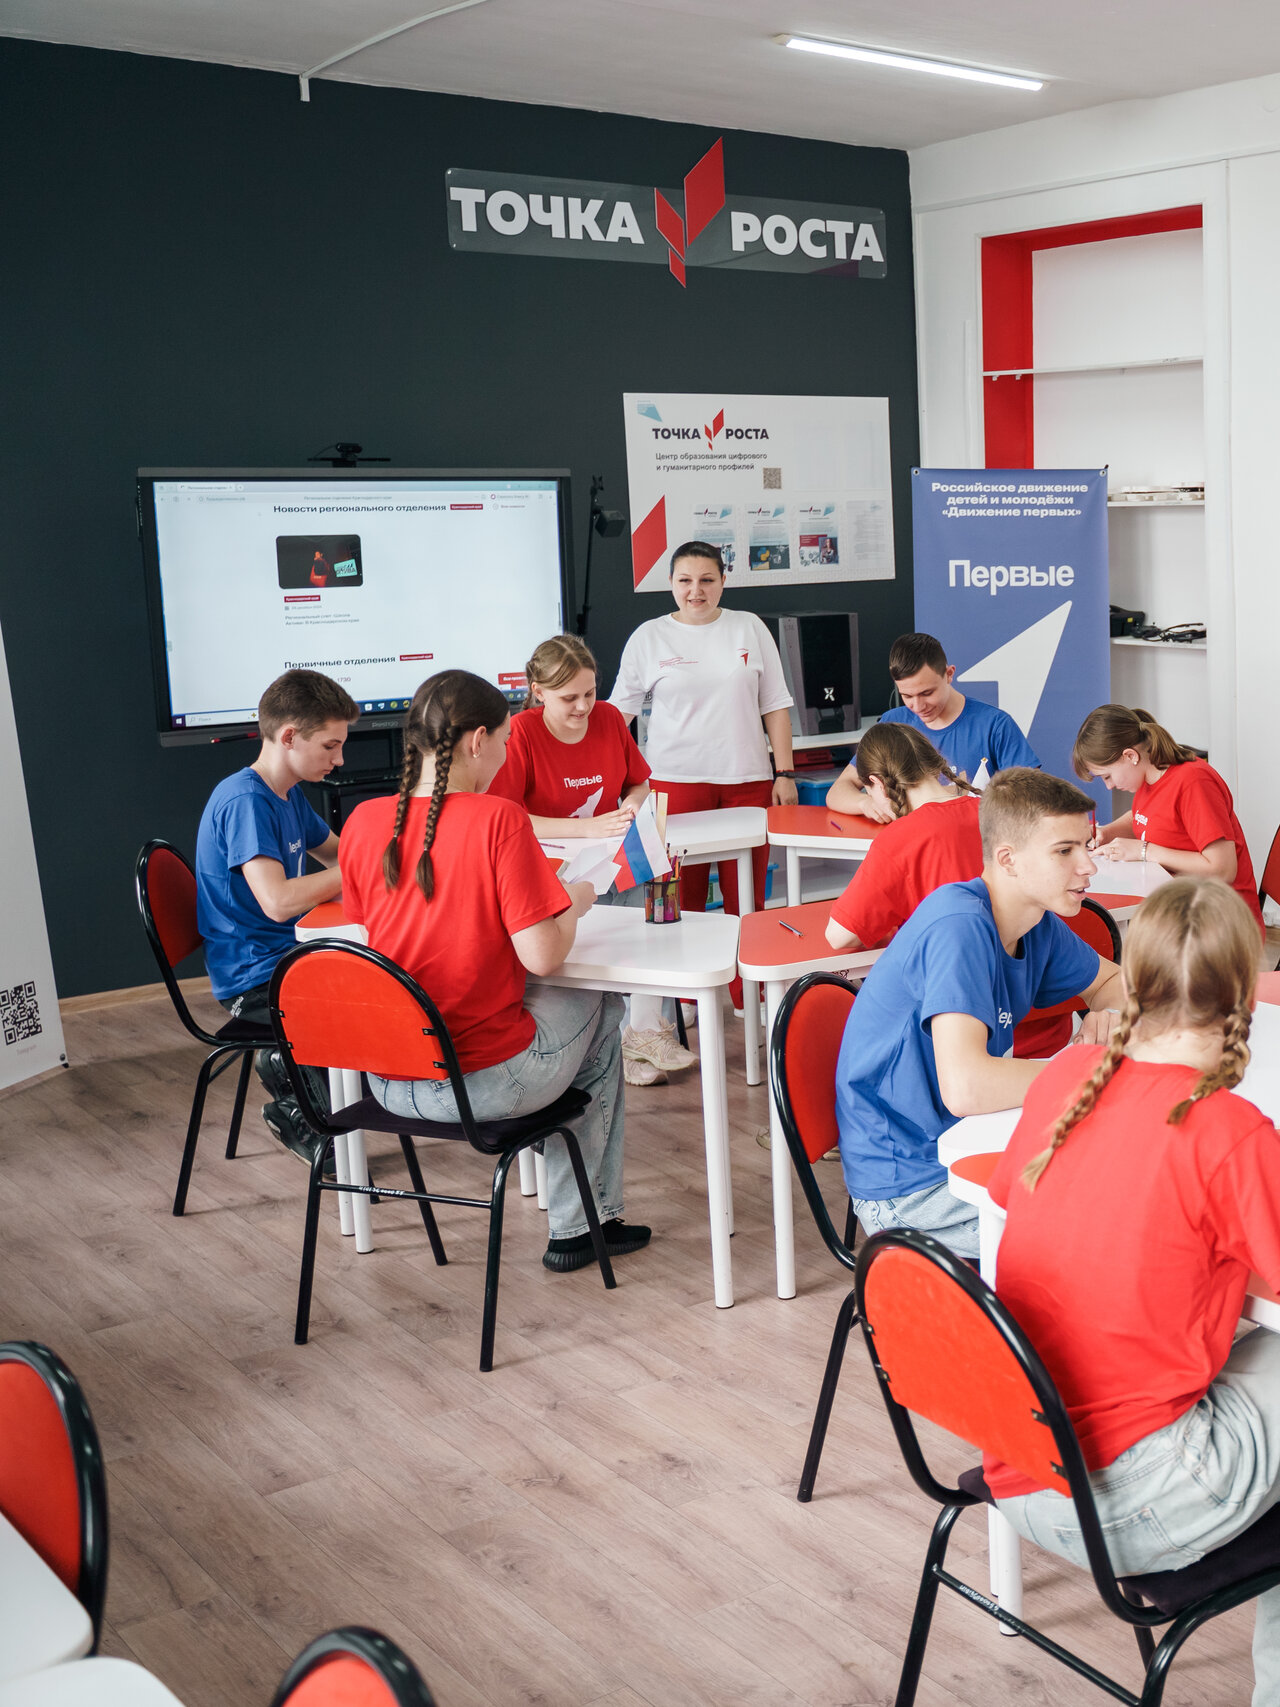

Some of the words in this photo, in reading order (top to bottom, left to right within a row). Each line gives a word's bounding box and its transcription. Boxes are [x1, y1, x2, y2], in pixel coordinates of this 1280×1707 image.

[450, 186, 645, 245] ТОЧКА
[731, 211, 885, 262] РОСТА
[652, 427, 701, 440] ТОЧКА
[725, 428, 770, 440] РОСТА
[655, 452, 678, 461] Центр
[680, 452, 727, 461] образования
[728, 452, 767, 461] цифрового
[662, 464, 717, 473] гуманитарного
[718, 463, 754, 472] профилей
[931, 482, 1016, 494] Российское
[1017, 483, 1089, 494] движение
[946, 494, 988, 506] детей
[990, 496, 999, 505] и
[1001, 494, 1074, 506] молодёжи
[273, 504, 318, 513] Новости
[319, 505, 394, 514] регионального
[395, 504, 447, 512] отделения
[942, 506, 1021, 518] «Движение
[1023, 508, 1082, 518] первых»
[949, 559, 1075, 596] Первые
[284, 660, 342, 669] Первичные
[344, 656, 396, 665] отделения
[563, 774, 603, 790] Первые
